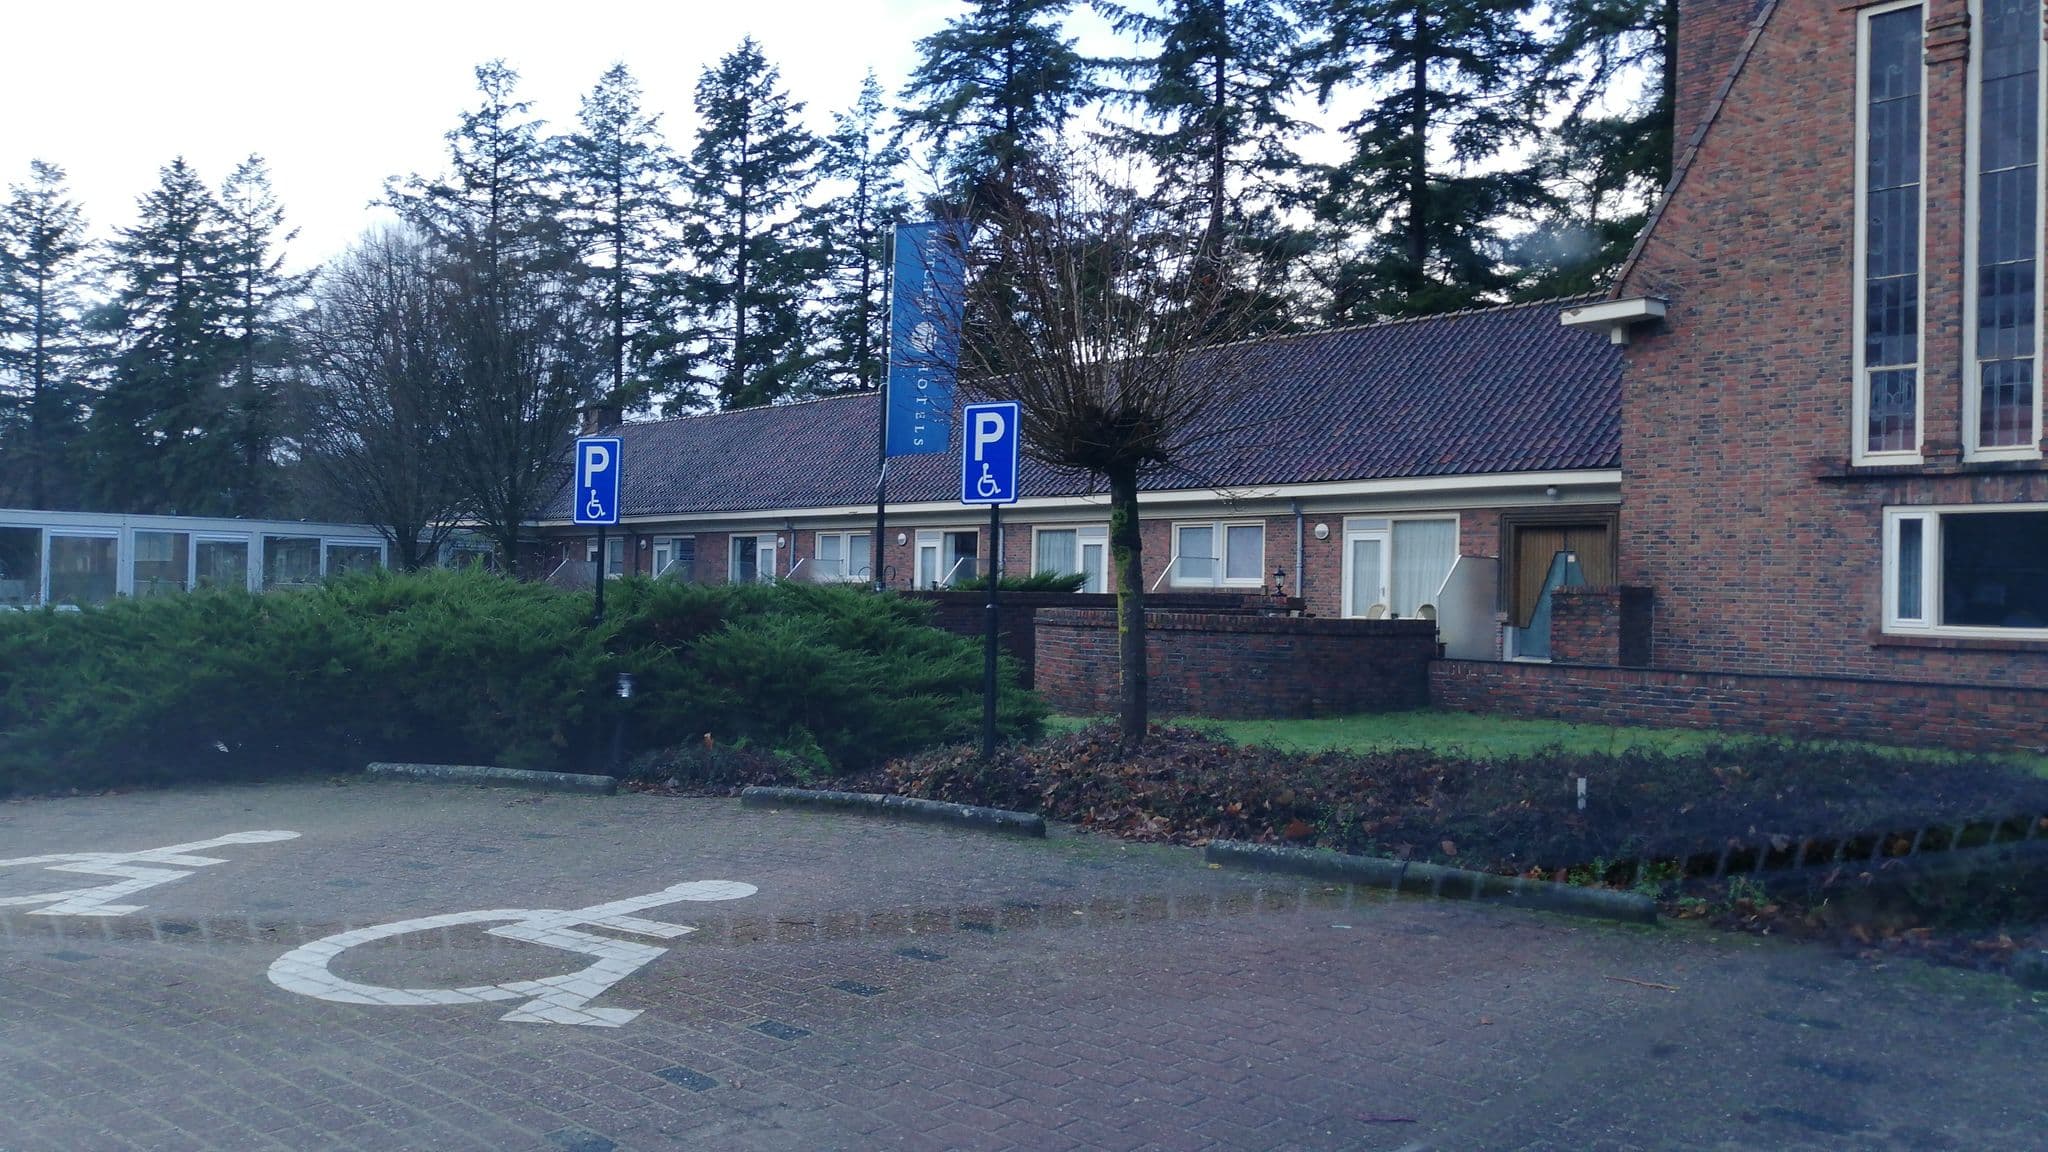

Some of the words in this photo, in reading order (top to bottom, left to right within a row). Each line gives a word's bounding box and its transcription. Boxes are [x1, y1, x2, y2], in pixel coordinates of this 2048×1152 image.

[913, 361, 929, 446] HOTELS
[974, 412, 1005, 462] P
[584, 445, 610, 488] P
